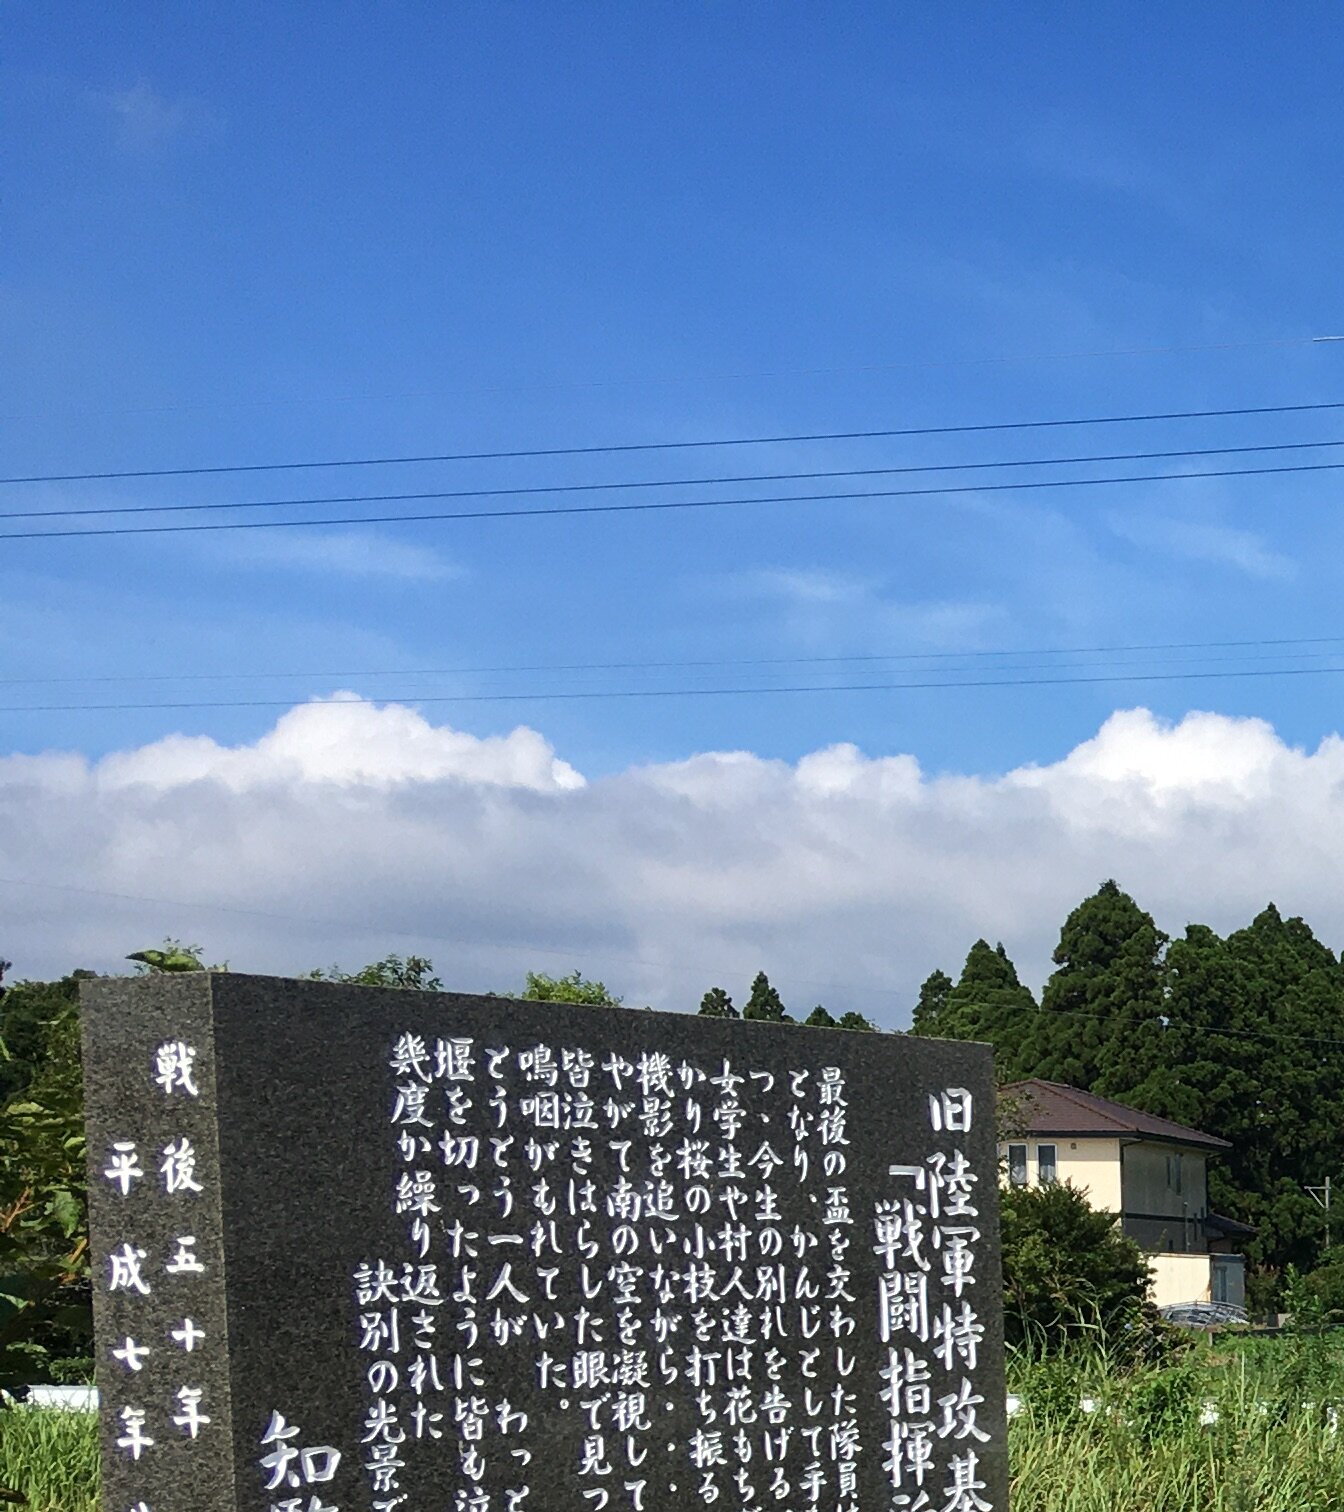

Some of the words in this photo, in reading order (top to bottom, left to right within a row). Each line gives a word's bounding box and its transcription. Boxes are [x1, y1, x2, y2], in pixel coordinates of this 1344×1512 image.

[156, 1042, 211, 1439] 戦後五十年
[389, 1031, 444, 1438] 幾度か繰り返された
[676, 1060, 727, 1503] かり桜の小枝を打ち振る
